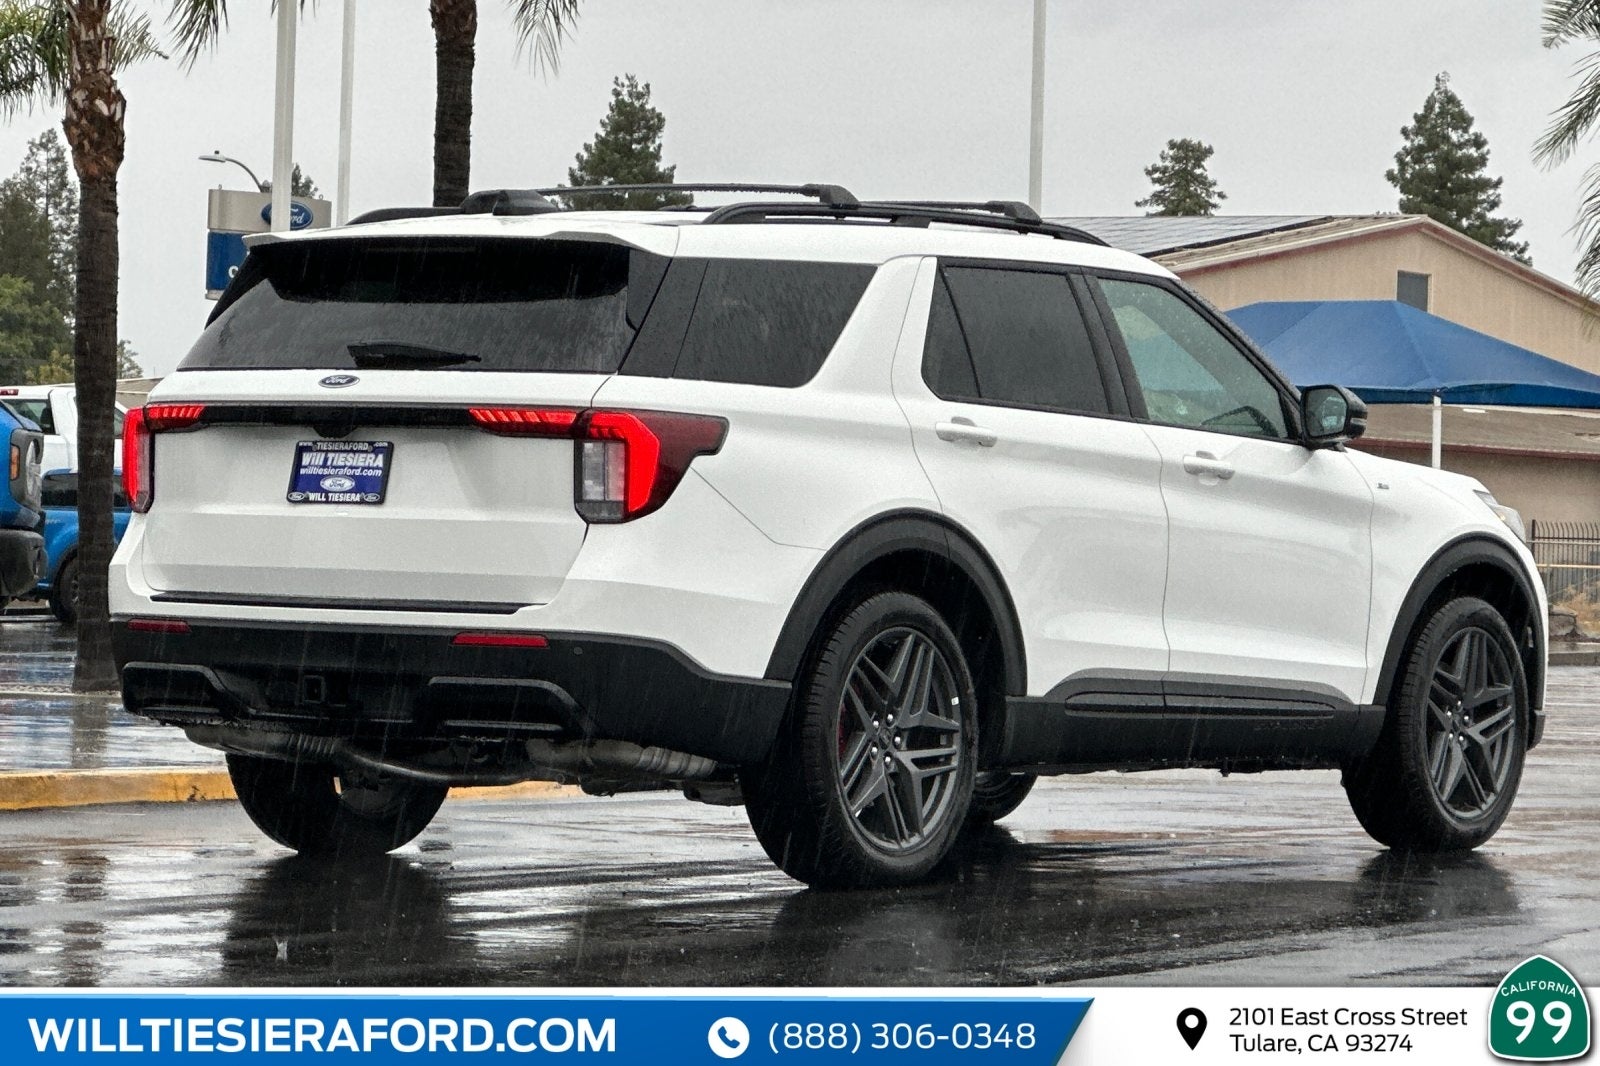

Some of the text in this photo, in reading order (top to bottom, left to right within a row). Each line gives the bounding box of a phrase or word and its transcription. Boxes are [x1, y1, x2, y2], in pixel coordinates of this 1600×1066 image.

[316, 442, 369, 451] TIESIERAFORD
[301, 452, 384, 467] Will TIESIERA
[300, 466, 383, 477] willtiesieraford.com
[309, 493, 360, 502] WILL TIESIERA
